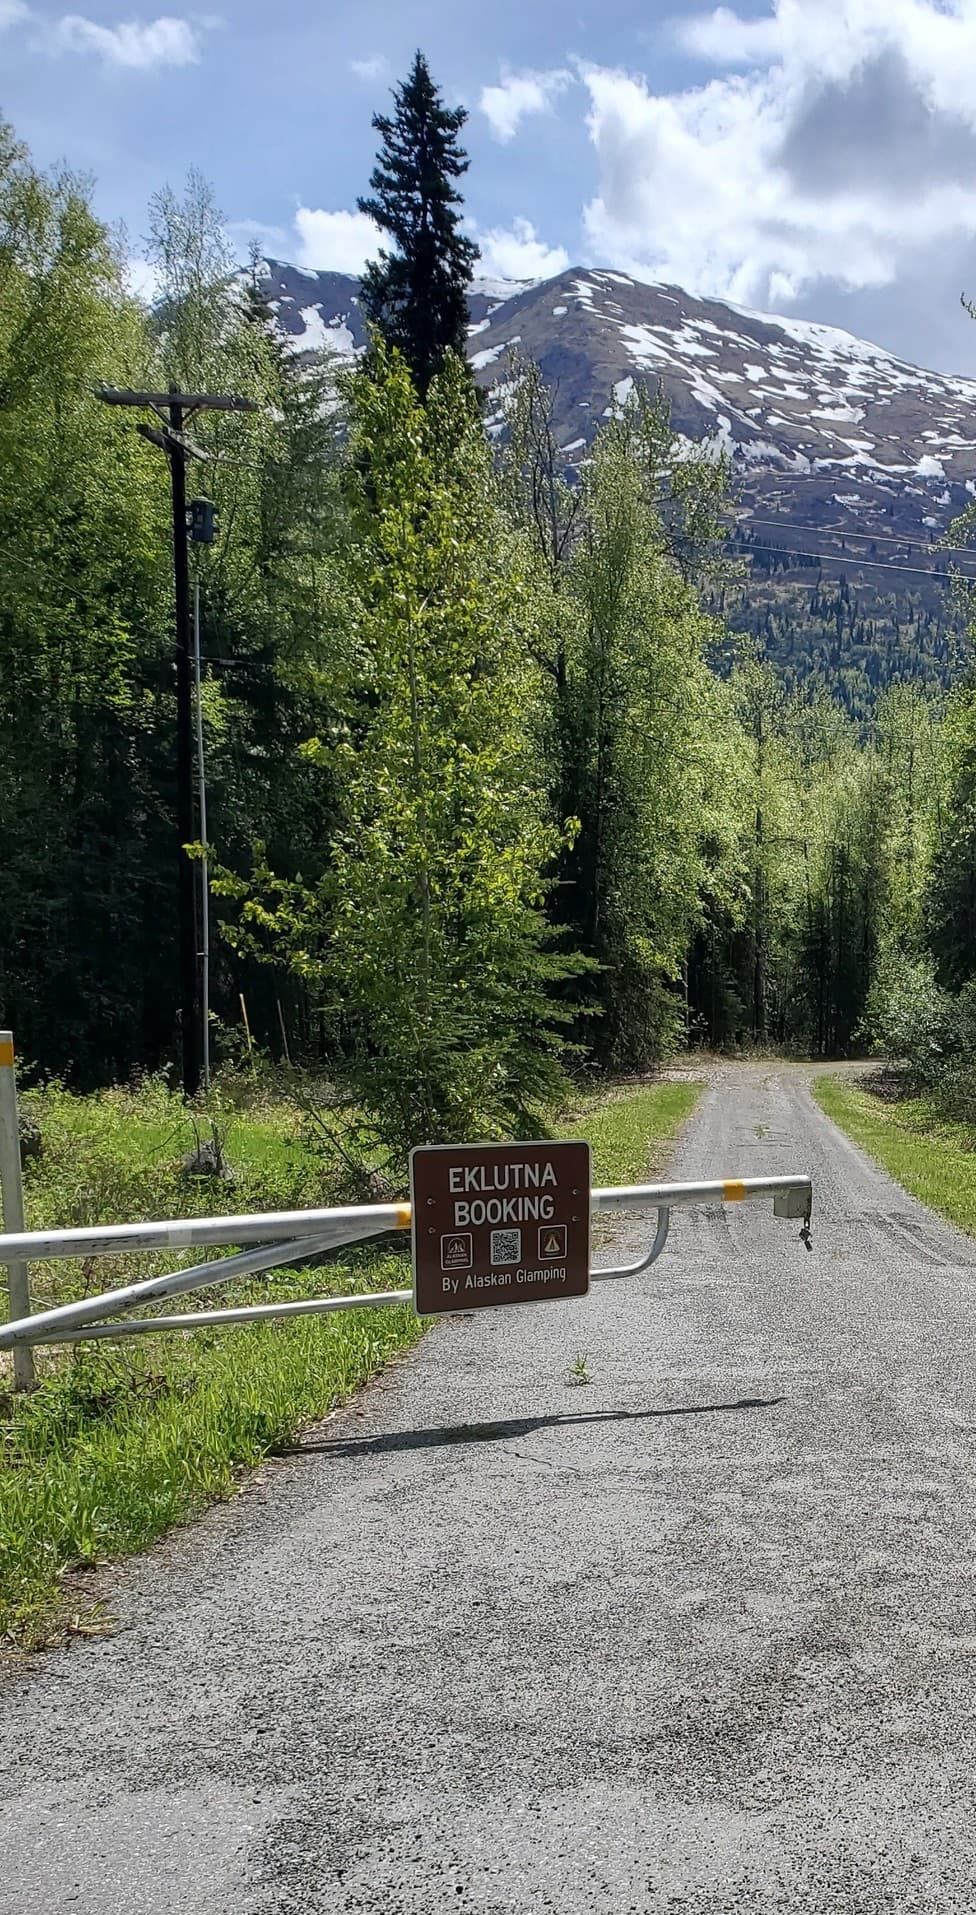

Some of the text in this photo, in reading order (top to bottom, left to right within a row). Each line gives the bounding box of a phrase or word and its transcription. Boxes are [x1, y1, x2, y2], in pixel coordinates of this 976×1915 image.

[449, 1163, 558, 1193] EKLUTNA
[454, 1195, 554, 1226] BOOKING
[442, 1266, 566, 1294] By Alaskan Glamping
